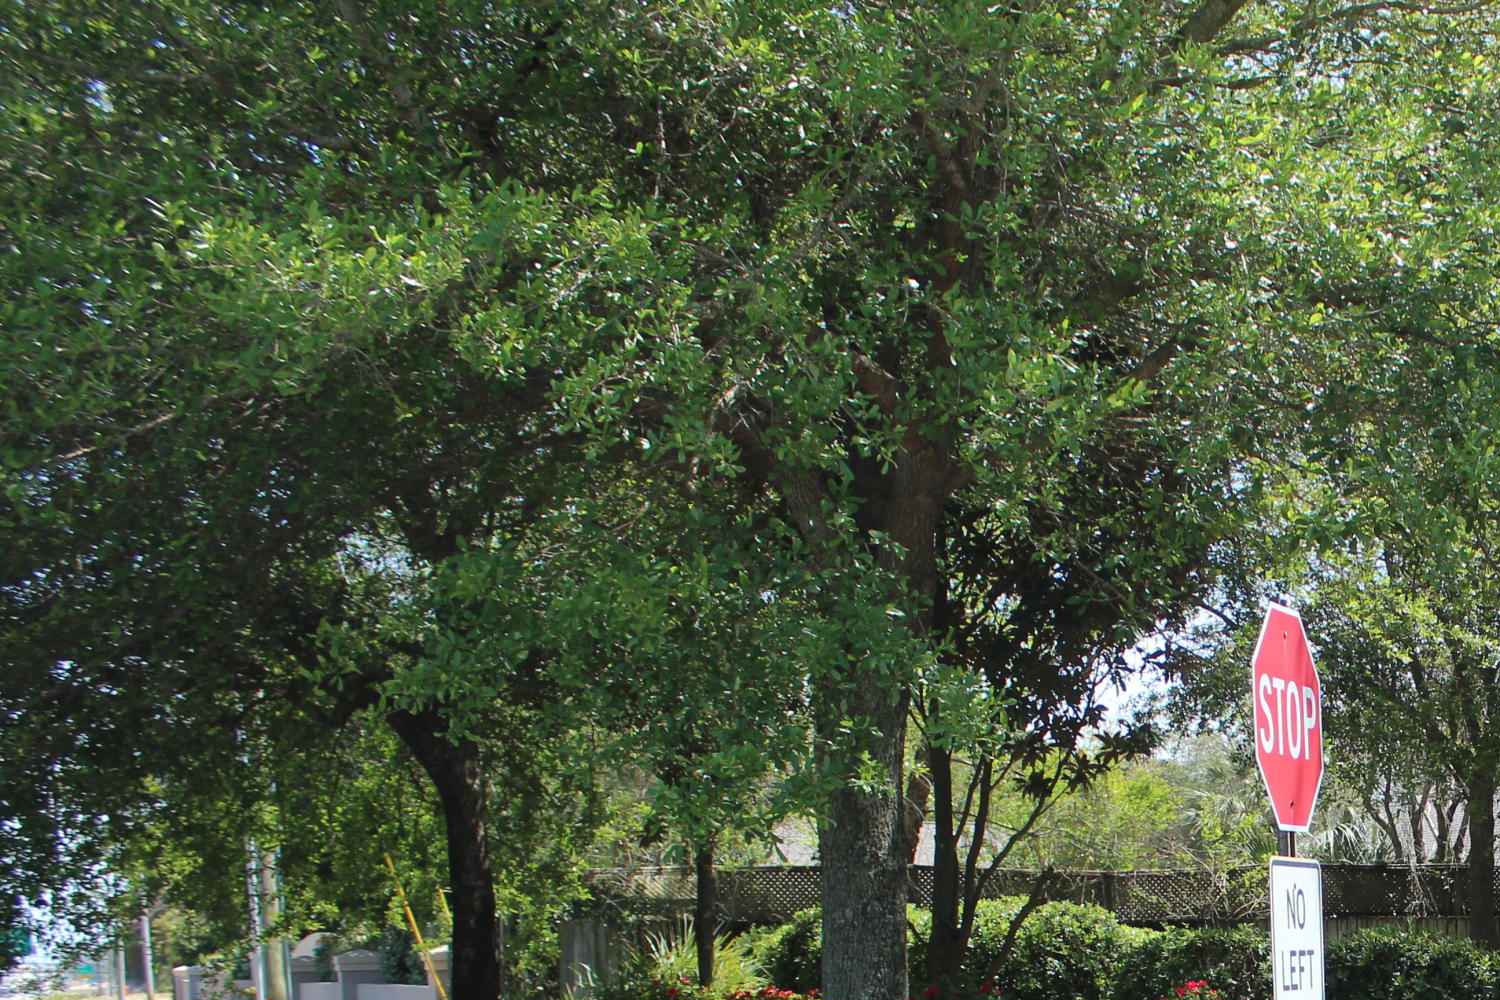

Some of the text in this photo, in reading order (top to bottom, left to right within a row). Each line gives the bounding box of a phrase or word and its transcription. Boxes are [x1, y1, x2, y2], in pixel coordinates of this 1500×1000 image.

[1259, 673, 1316, 760] STOP
[1286, 888, 1306, 930] NO
[1281, 950, 1315, 991] LEFT
